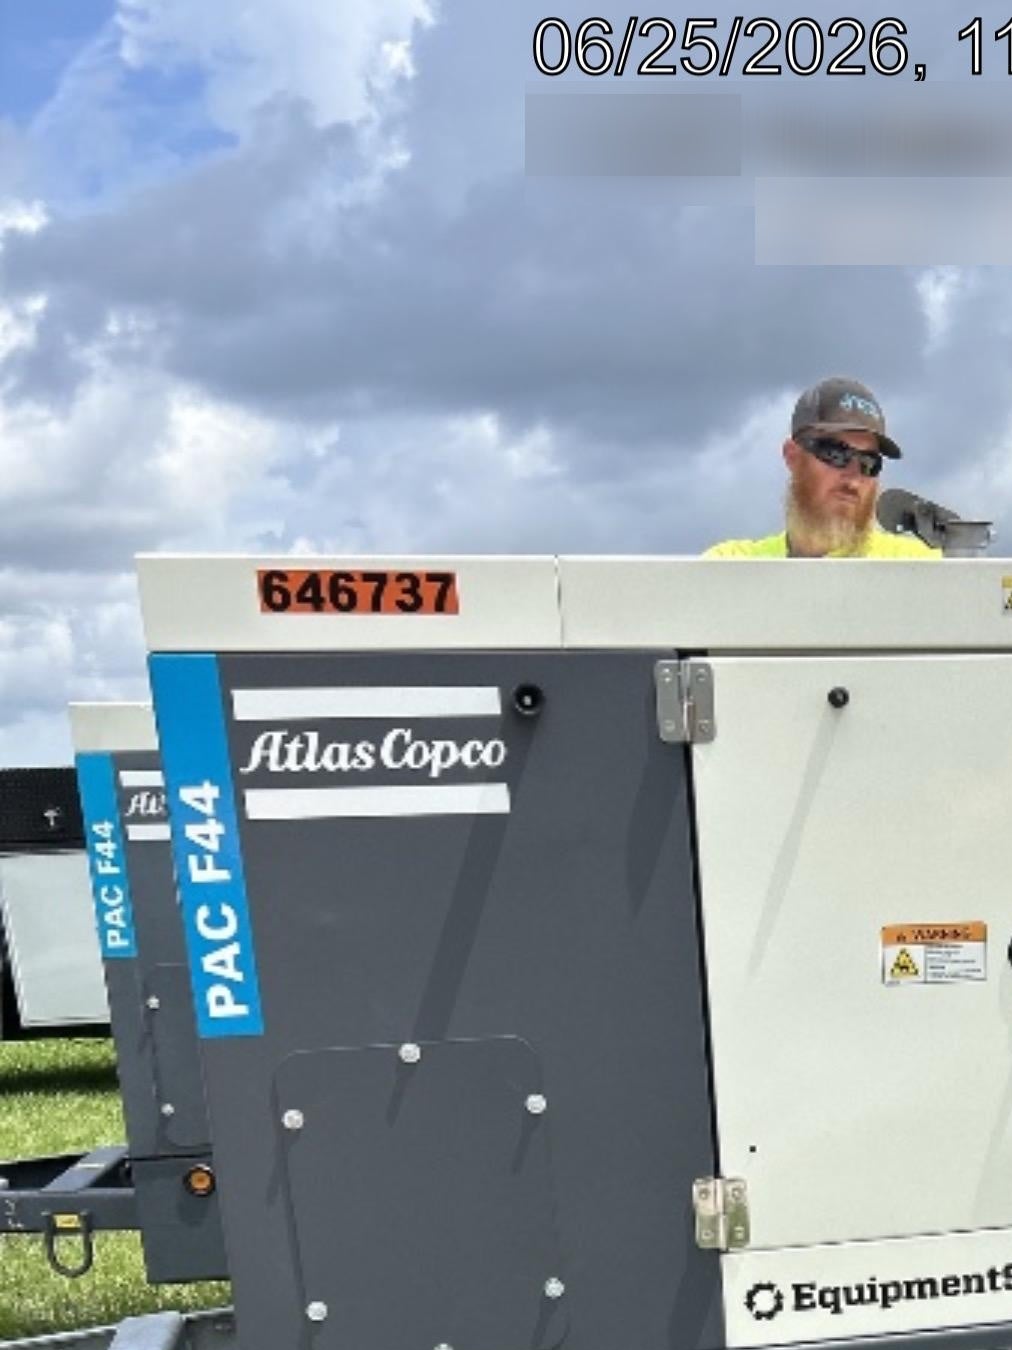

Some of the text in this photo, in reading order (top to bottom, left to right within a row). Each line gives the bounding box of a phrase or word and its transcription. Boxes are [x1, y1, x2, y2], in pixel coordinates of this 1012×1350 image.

[260, 571, 456, 613] 646737
[240, 728, 507, 777] Atlas Copco
[93, 820, 129, 949] PAC F44
[179, 780, 250, 1018] PAC F44
